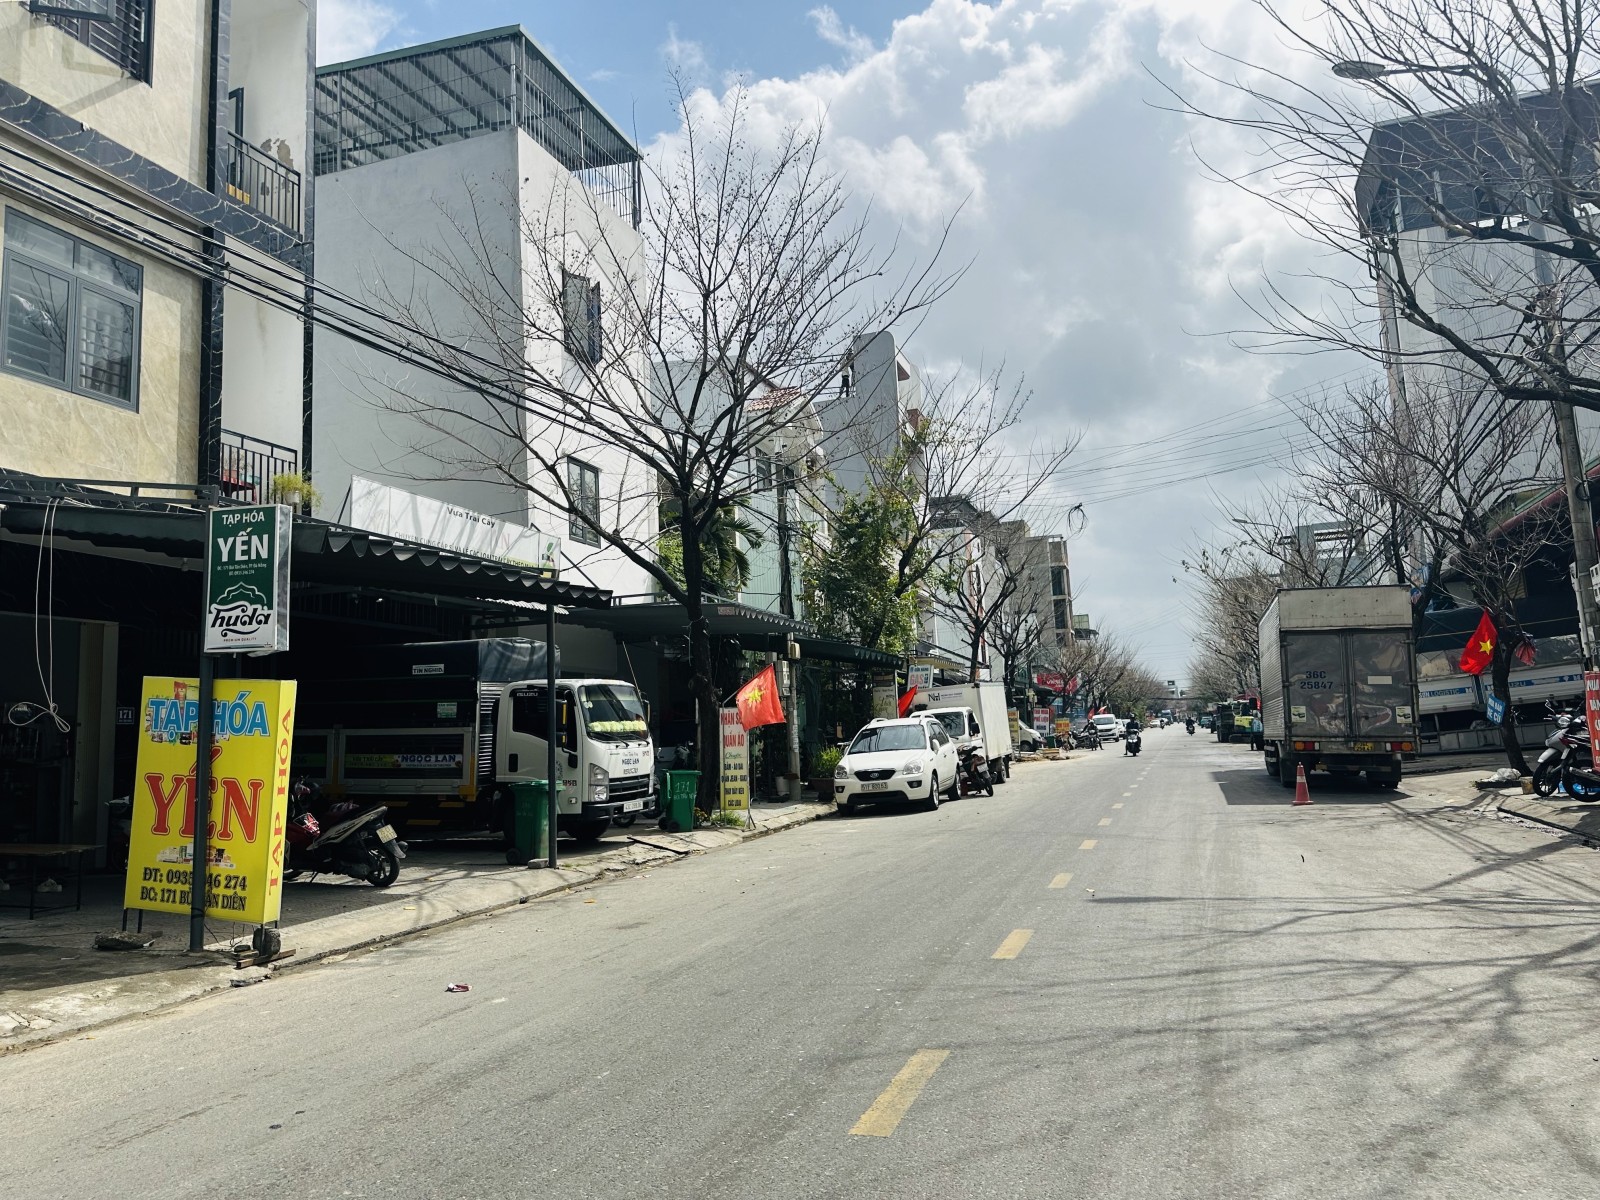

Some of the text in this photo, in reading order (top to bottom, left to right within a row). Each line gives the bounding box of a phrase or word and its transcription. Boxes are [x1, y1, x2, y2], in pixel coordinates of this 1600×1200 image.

[222, 510, 265, 528] TẠP HÓA
[217, 527, 269, 563] YẾN
[910, 673, 925, 685] GAS
[1300, 681, 1334, 690] 25847
[1305, 670, 1327, 679] 36C
[119, 710, 132, 719] 171
[148, 691, 270, 741] TẠP HÓA
[277, 707, 291, 796] HÓA
[435, 754, 456, 762] LAN
[144, 746, 264, 843] YẾN
[268, 811, 284, 896] TẠP
[143, 867, 163, 883] ĐT:
[224, 874, 247, 891] 274
[140, 886, 158, 902] ĐC:
[160, 888, 177, 904] 171
[221, 891, 247, 911] DIÊN
